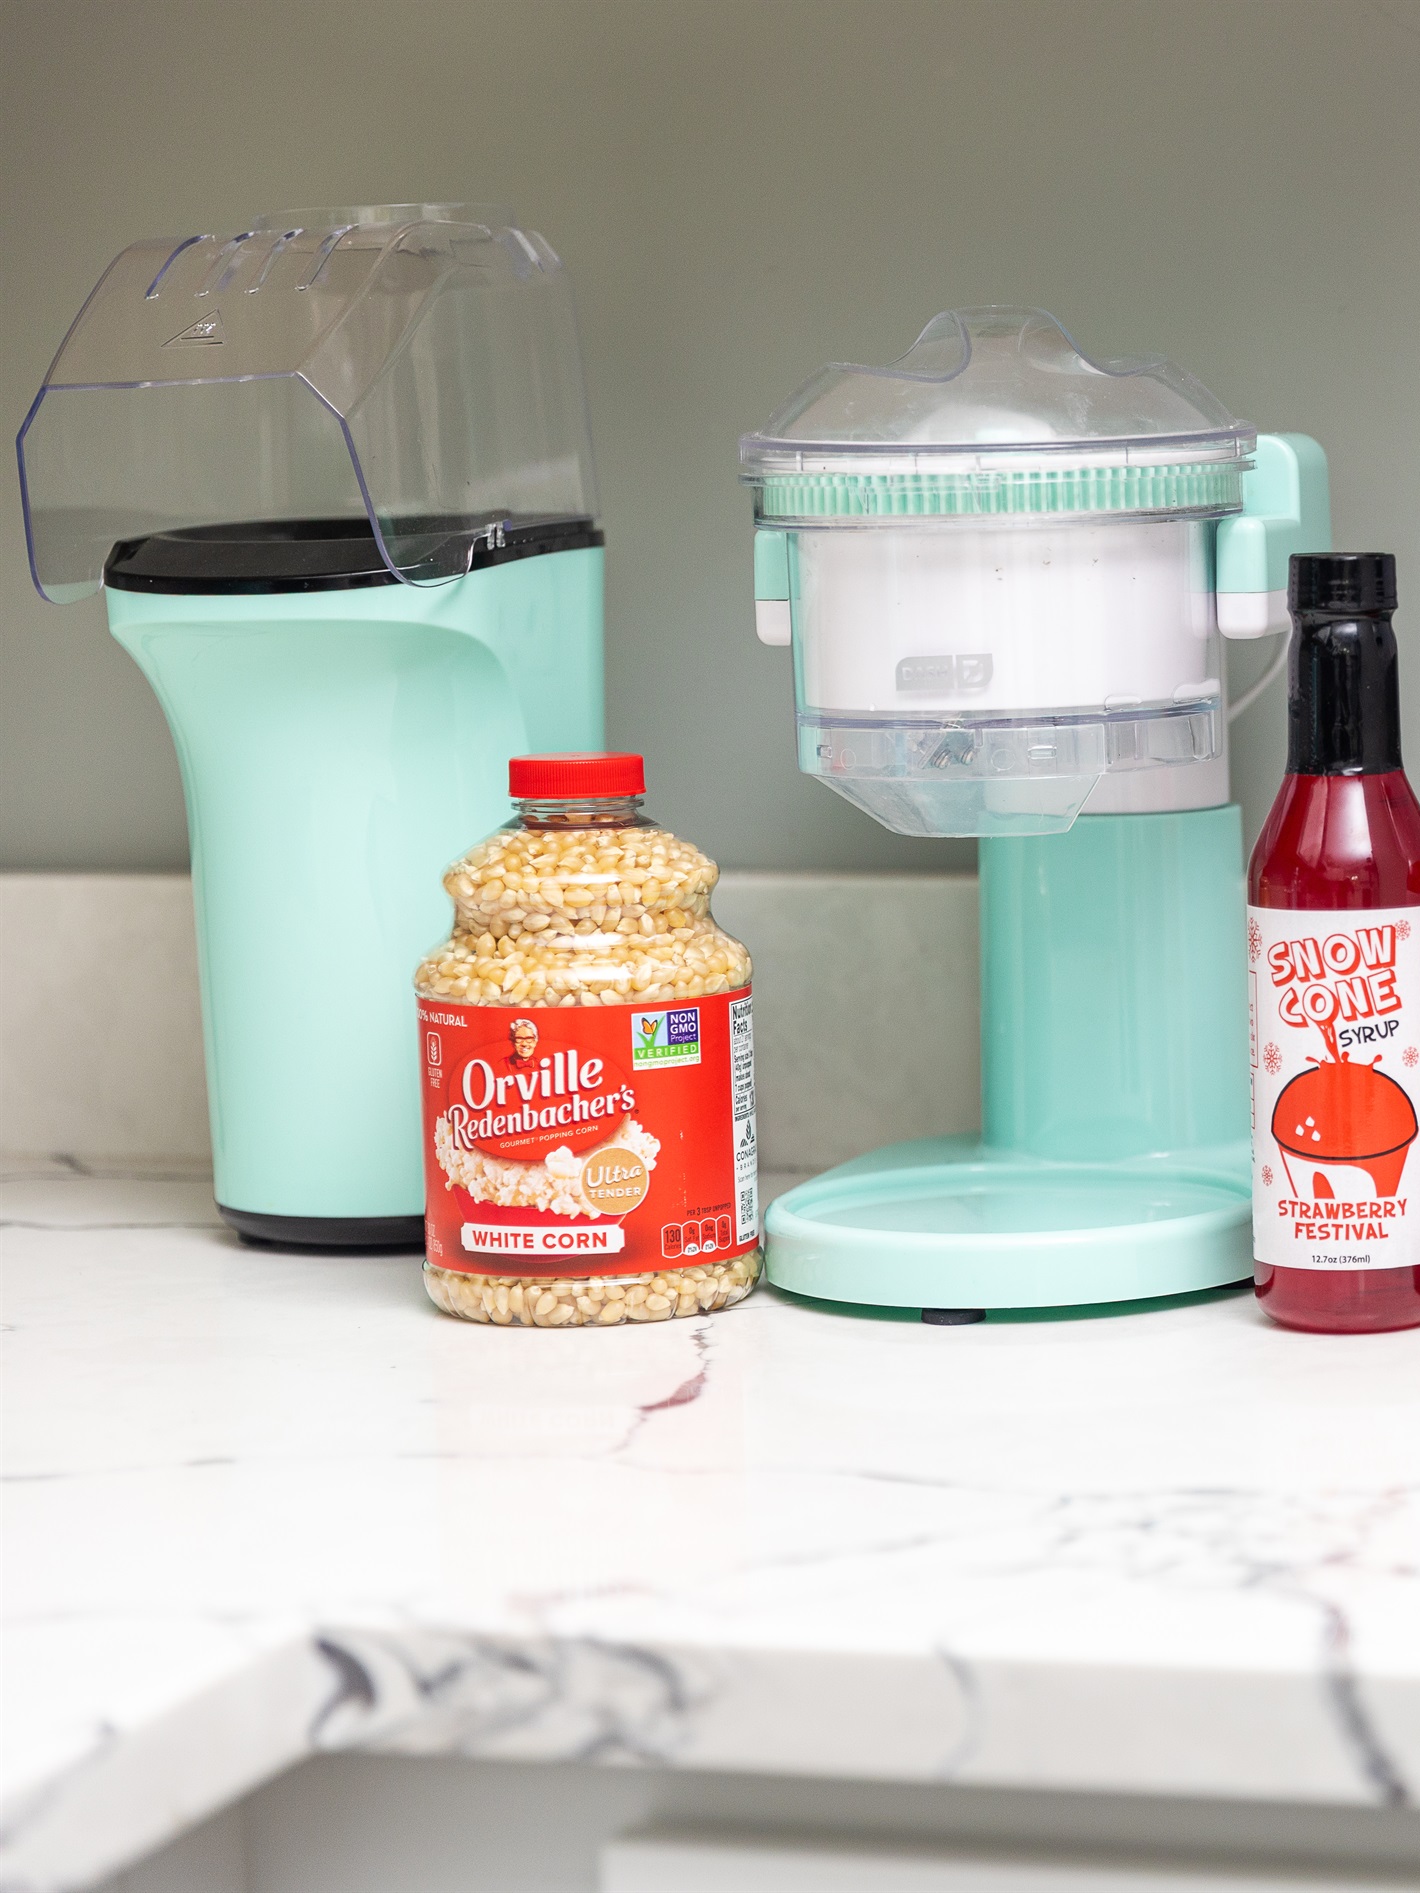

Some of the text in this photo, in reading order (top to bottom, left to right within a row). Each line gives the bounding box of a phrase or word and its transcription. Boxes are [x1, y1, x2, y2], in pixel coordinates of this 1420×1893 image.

[1267, 924, 1396, 987] SNOW
[1278, 968, 1403, 1028] CONE
[429, 1011, 468, 1028] NATURAL
[669, 1012, 696, 1024] NON
[669, 1022, 697, 1034] GMO
[1338, 1018, 1400, 1048] SYRUP
[670, 1033, 697, 1044] Project
[637, 1044, 697, 1059] VERIFIED
[634, 1055, 700, 1068] nongmoproject.org
[427, 1066, 443, 1079] GLUTEN
[462, 1049, 604, 1110] Orville
[430, 1077, 441, 1089] FREE
[448, 1084, 635, 1150] Redenbacher's
[500, 1125, 599, 1149] GOURMET POPPING CORN
[586, 1165, 642, 1188] Ultra
[588, 1186, 641, 1199] TENDER
[696, 1206, 701, 1216] 3
[1277, 1198, 1408, 1220] STRAWBERRY
[665, 1229, 681, 1243] 130
[1294, 1221, 1389, 1241] FESTIVAL
[472, 1230, 607, 1250] WHITE CORN
[1339, 1253, 1371, 1265] (376ml)
